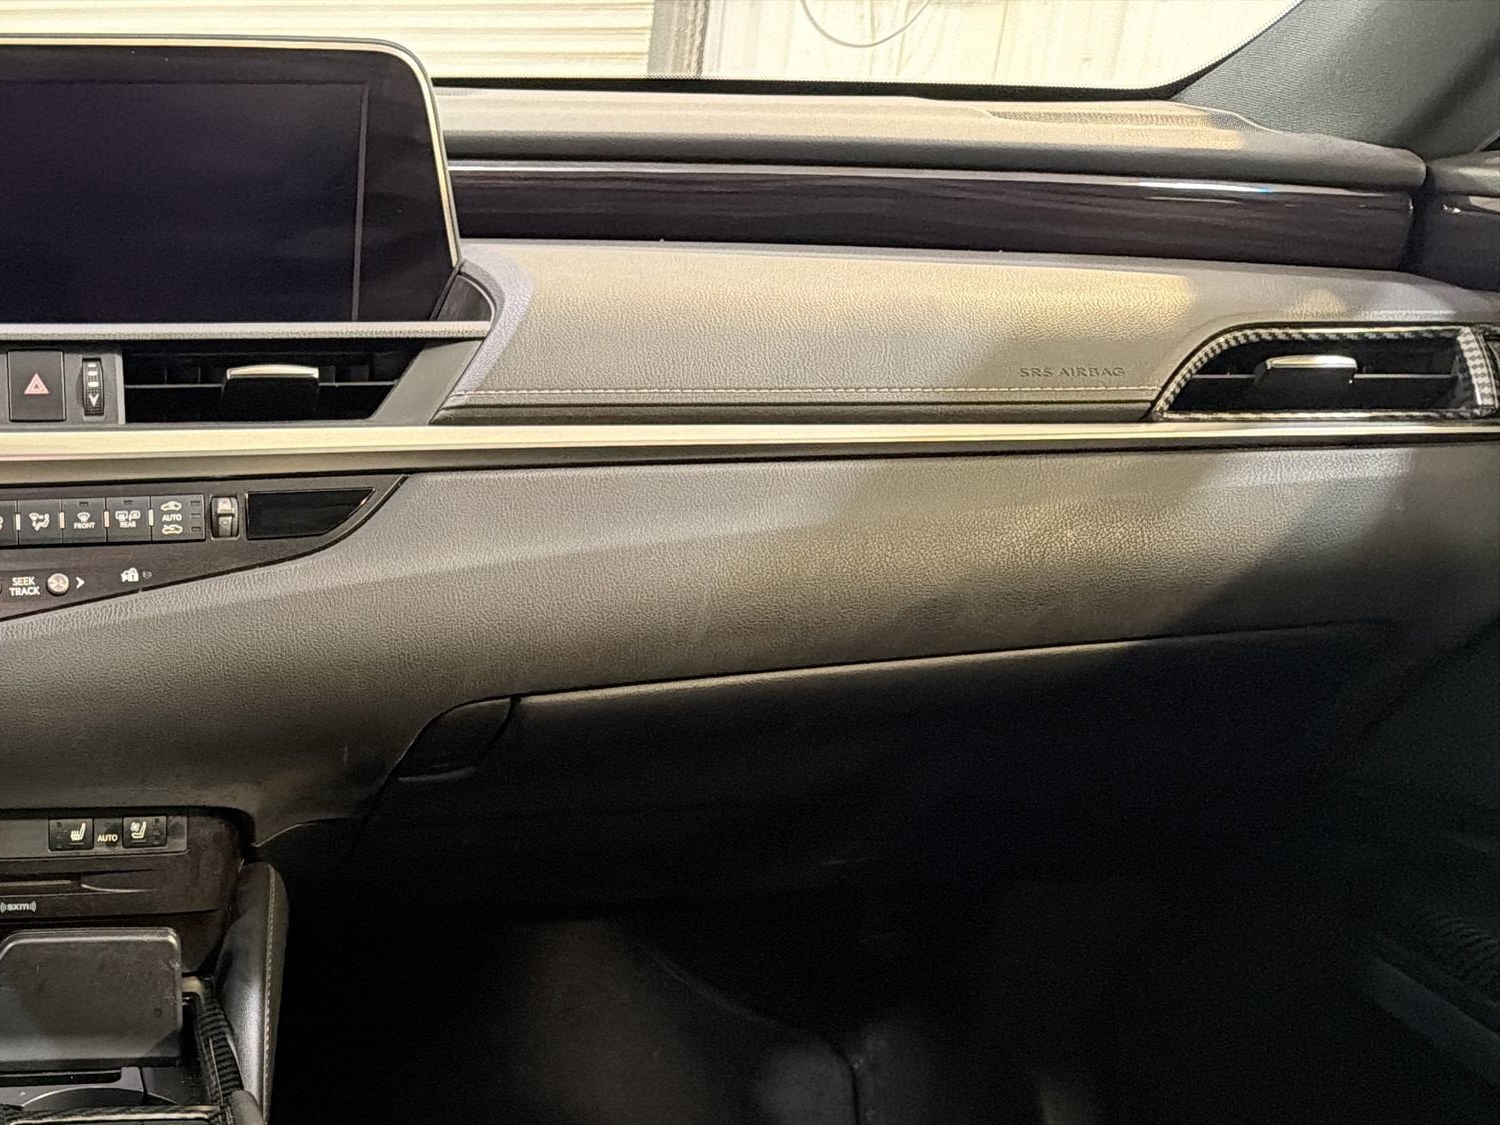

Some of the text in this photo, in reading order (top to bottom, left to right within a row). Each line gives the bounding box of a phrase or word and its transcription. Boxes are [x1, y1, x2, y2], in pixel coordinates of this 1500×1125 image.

[1020, 367, 1125, 378] SRS AIRBAG
[162, 514, 182, 522] AUTO
[74, 521, 96, 530] FRONT
[12, 576, 36, 586] SEEK
[9, 586, 40, 597] TRACK
[98, 834, 118, 842] AUTO
